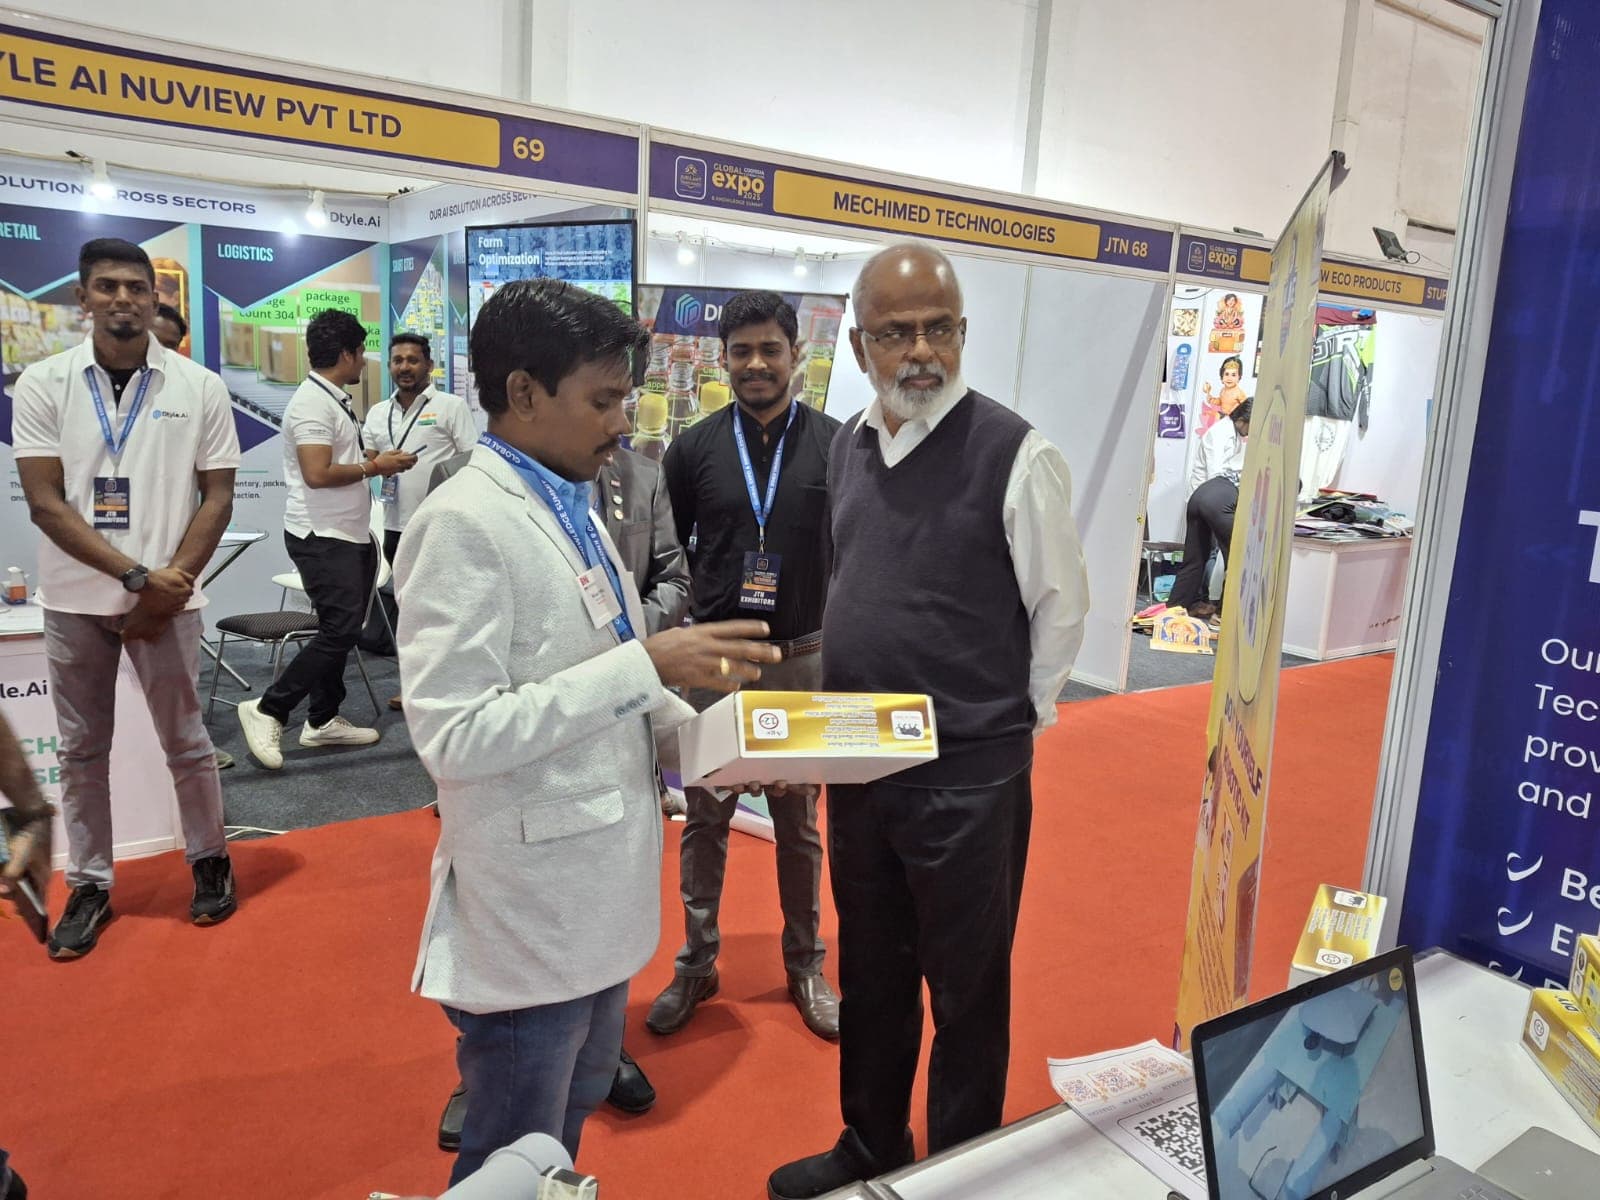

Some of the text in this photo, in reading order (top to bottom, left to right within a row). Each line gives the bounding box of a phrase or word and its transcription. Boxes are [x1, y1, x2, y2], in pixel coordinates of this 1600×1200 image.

[0, 51, 402, 138] LE AI NUVIEW PVT LTD
[512, 136, 545, 162] 69
[713, 162, 742, 175] GLOBAL
[712, 171, 765, 196] expo
[172, 196, 256, 215] SECTORS
[743, 191, 761, 201] 2025
[429, 208, 443, 221] OUR
[442, 207, 449, 218] AI
[449, 199, 481, 217] SOLUTION
[482, 192, 512, 208] ACROSS
[330, 211, 381, 228] Dtyle.Ai
[833, 191, 1056, 244] MECHIMED TECHNOLOGIES
[478, 236, 503, 249] Farm
[1104, 237, 1148, 258] JTN 68
[217, 243, 274, 262] LOGISTICS
[478, 251, 540, 268] Optimization
[1208, 251, 1237, 268] expo
[1332, 271, 1352, 286] ECO
[1353, 274, 1402, 294] PRODUCTS
[305, 292, 351, 304] package
[275, 311, 295, 321] 304
[541, 479, 565, 512] SUMMIT
[1518, 780, 1592, 820] and
